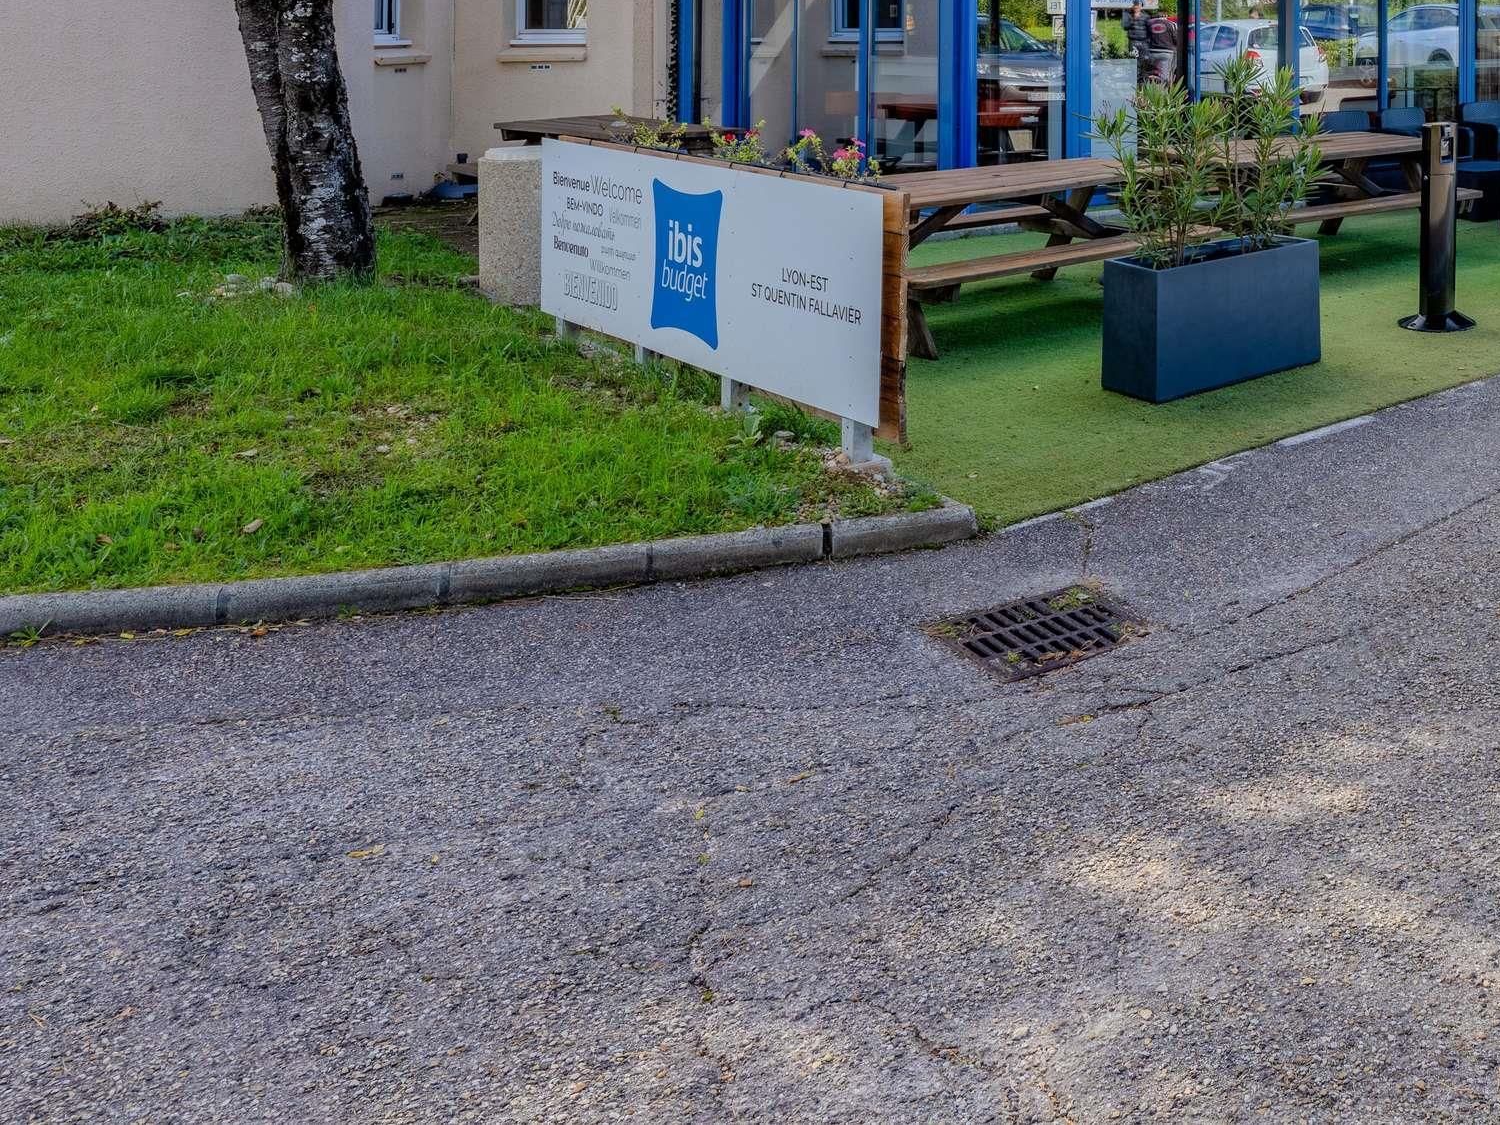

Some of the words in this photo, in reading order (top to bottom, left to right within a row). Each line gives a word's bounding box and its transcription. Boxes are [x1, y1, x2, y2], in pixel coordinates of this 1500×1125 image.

[552, 171, 591, 192] Bienvenue
[590, 173, 643, 205] Welcome
[566, 196, 604, 217] BEM-VINDO
[668, 219, 703, 267] ibis
[661, 258, 709, 302] budget
[781, 267, 829, 292] LYON-EST
[751, 283, 763, 299] ST
[764, 286, 807, 312] QUENTIN
[808, 297, 862, 326] FALLAVIER
